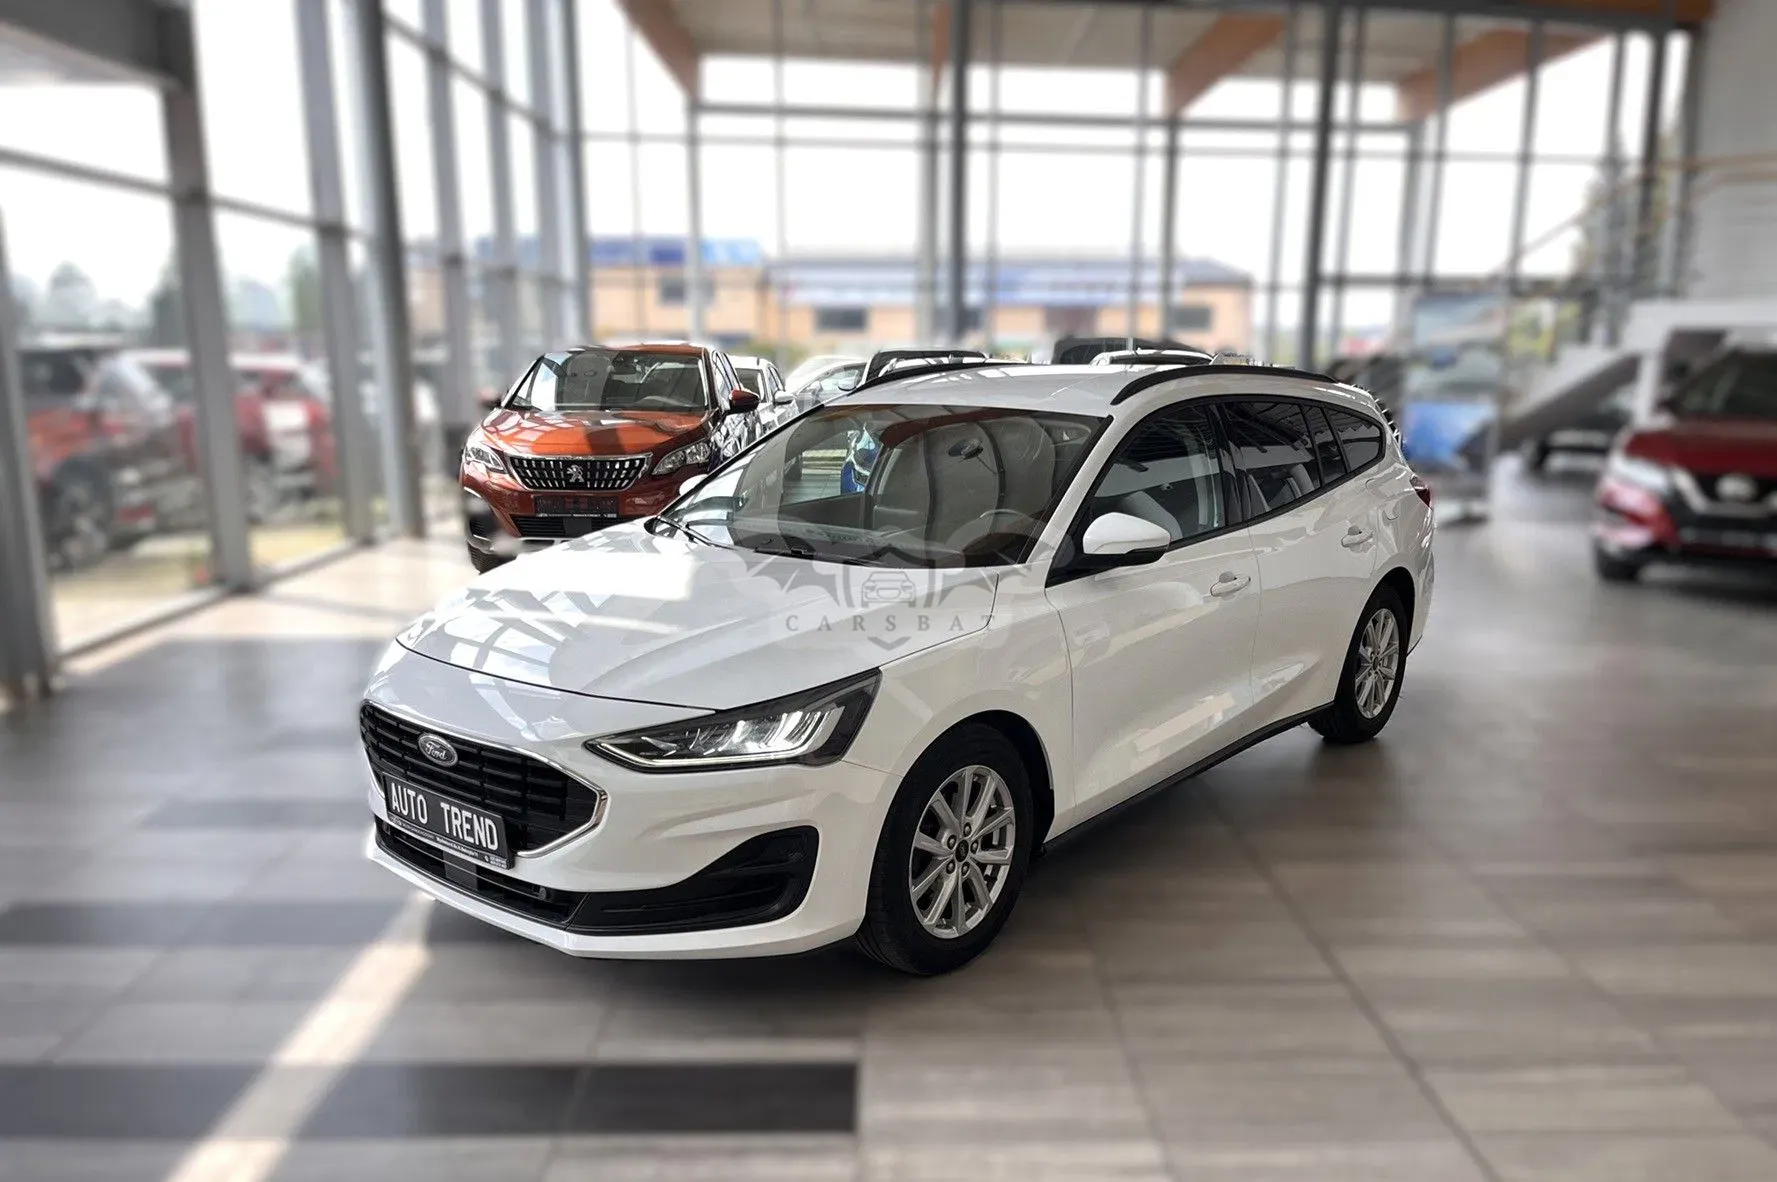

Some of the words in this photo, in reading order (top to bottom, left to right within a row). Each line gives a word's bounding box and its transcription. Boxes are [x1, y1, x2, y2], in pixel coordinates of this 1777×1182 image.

[425, 741, 448, 760] Ford
[391, 782, 428, 825] AUTO
[440, 802, 499, 851] TREND
